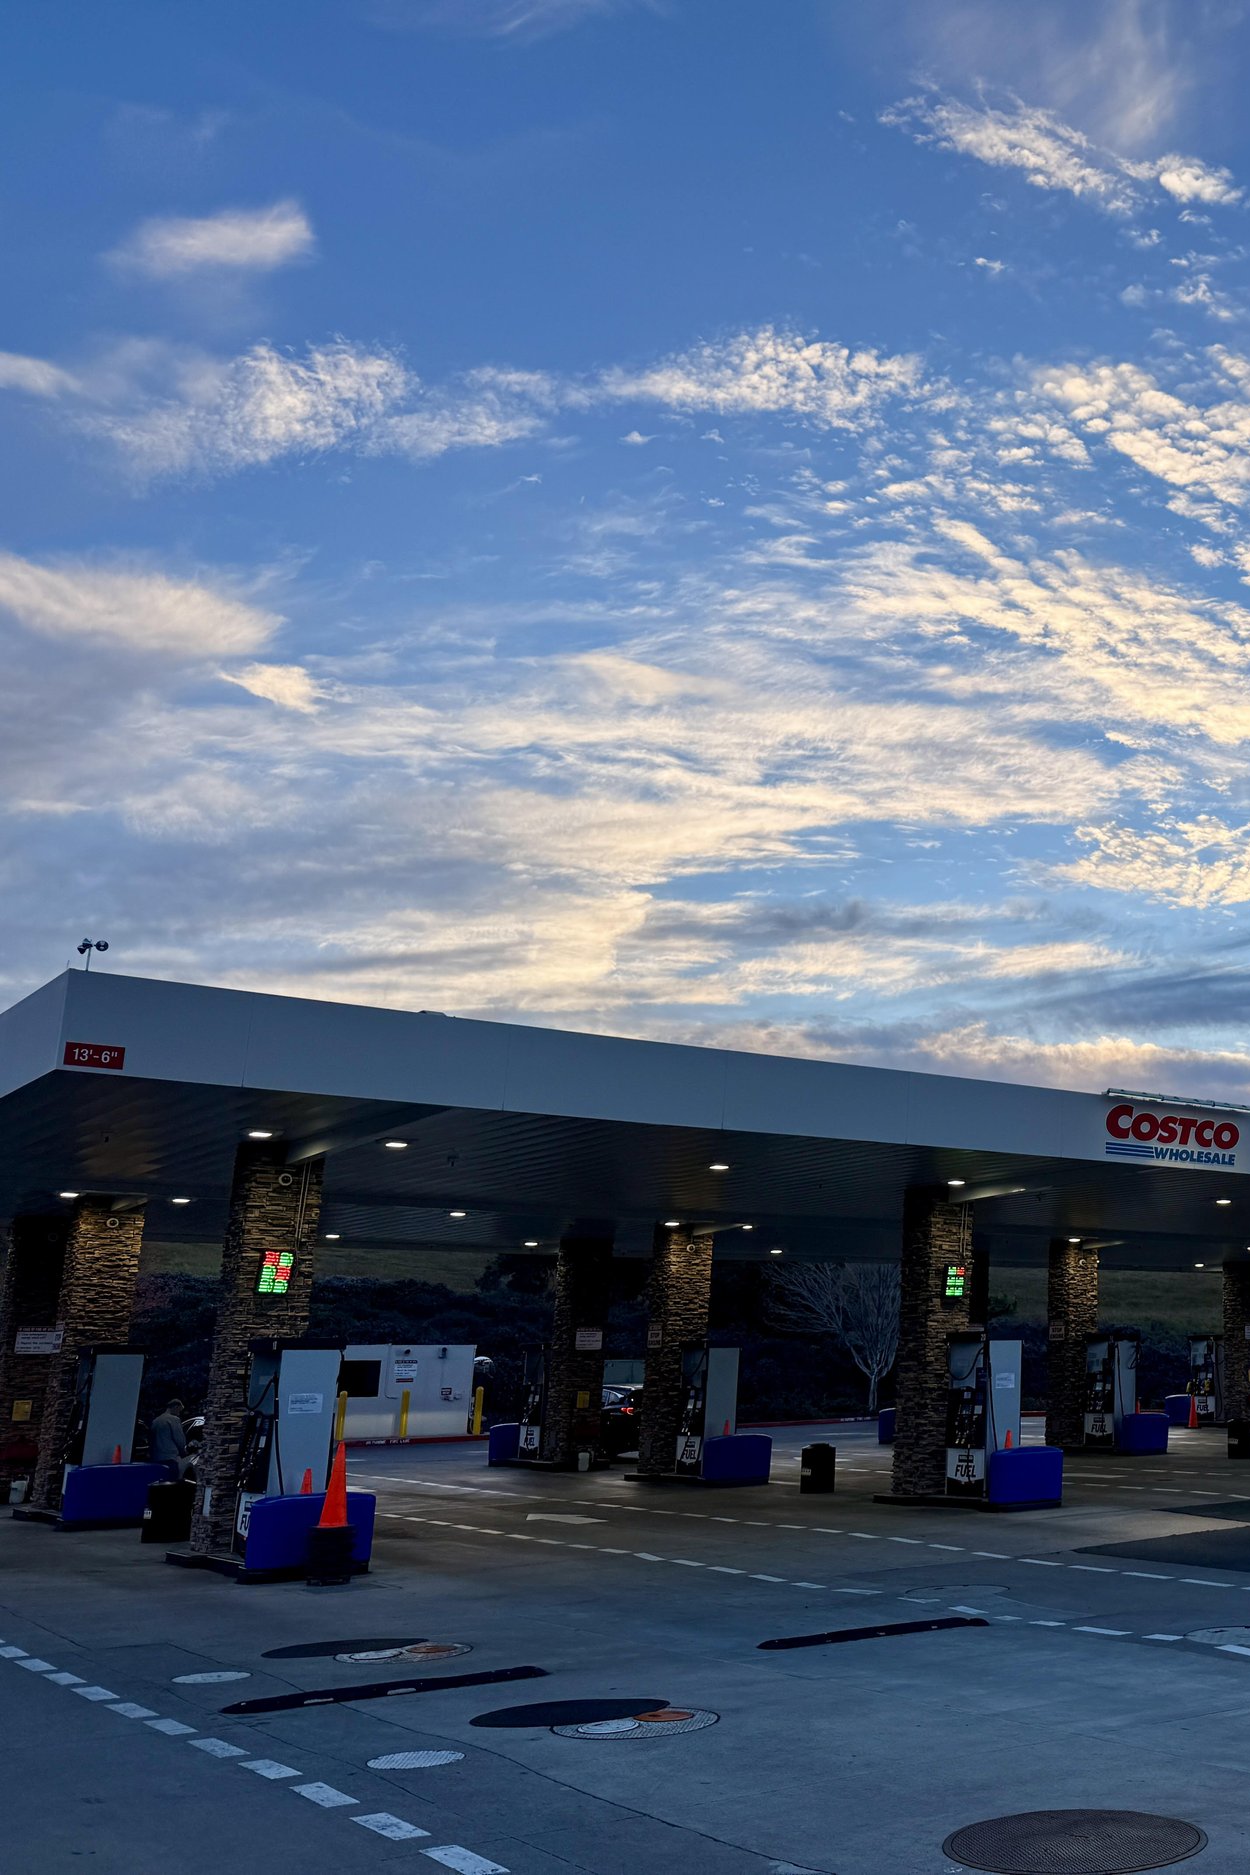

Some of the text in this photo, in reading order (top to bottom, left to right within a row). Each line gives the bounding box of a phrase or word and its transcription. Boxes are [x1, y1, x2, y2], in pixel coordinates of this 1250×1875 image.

[73, 1047, 118, 1063] 13'-6"
[1106, 1104, 1239, 1149] COSTCO
[1153, 1146, 1236, 1166] WHOLESALE
[682, 1449, 696, 1460] FUEL
[955, 1463, 977, 1478] FUEL
